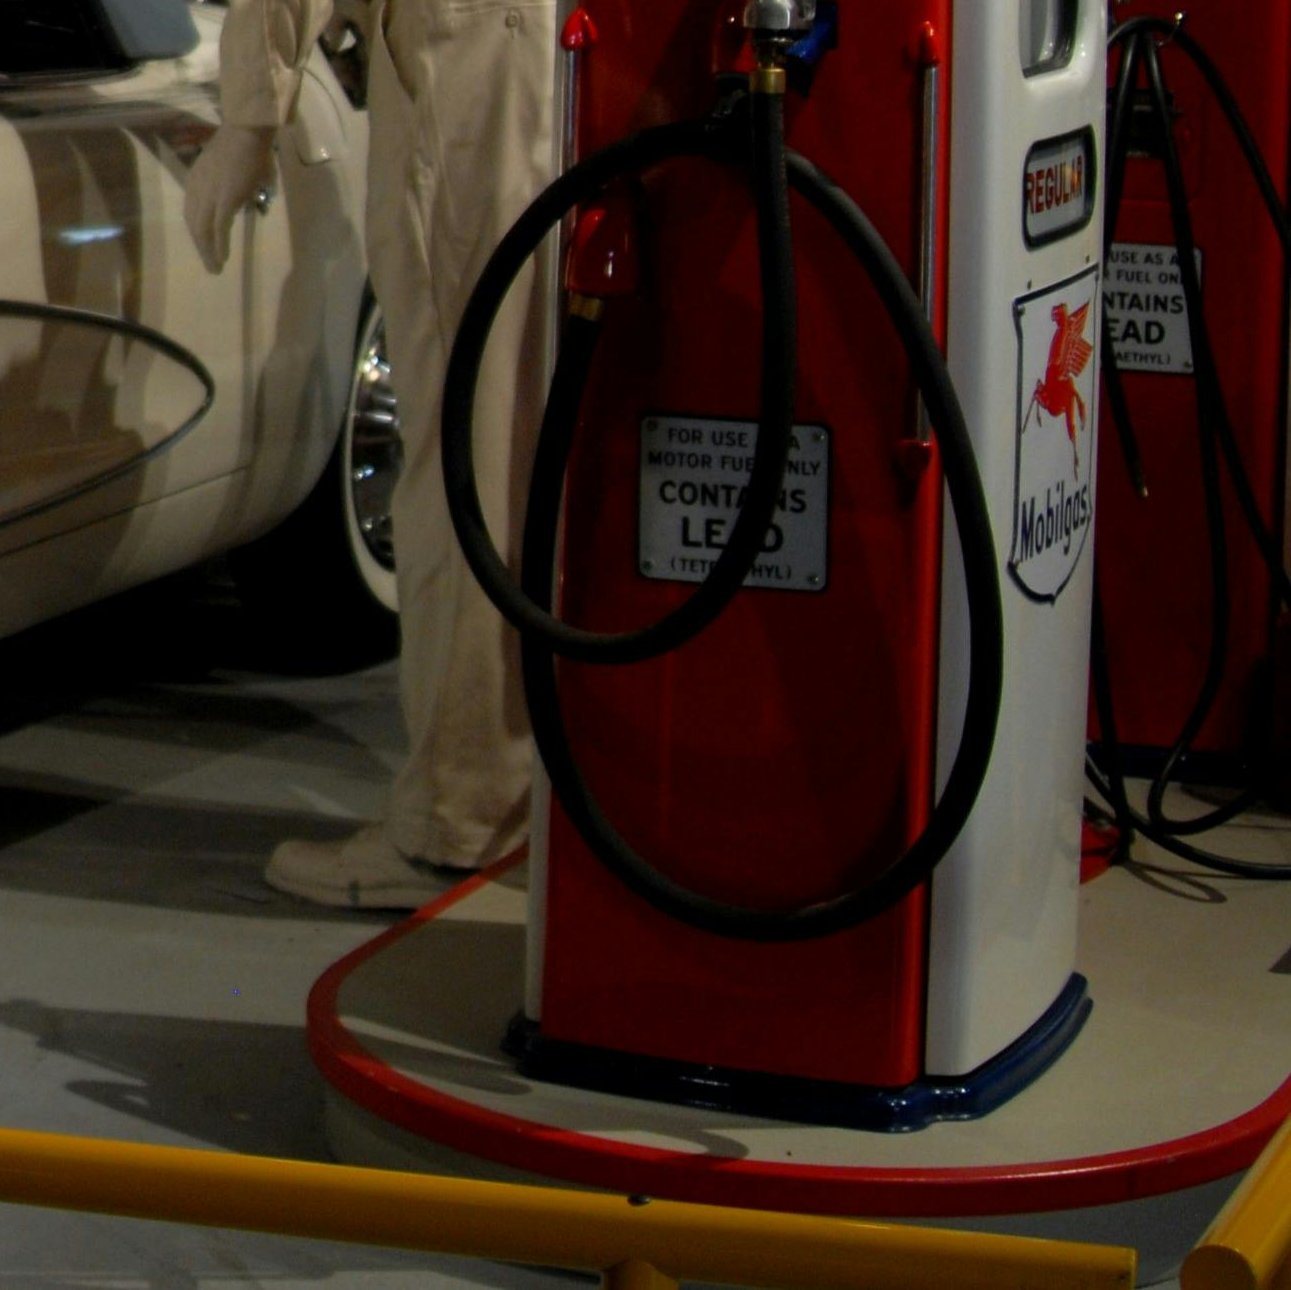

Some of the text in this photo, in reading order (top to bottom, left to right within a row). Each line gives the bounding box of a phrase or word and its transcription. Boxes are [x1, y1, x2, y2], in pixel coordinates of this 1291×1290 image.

[1026, 155, 1083, 214] REGULAR
[1144, 252, 1164, 265] AS
[1116, 269, 1151, 283] FUEL
[1103, 291, 1184, 314] NTAINS
[1107, 318, 1165, 345] EAD
[668, 428, 702, 445] FOR
[712, 431, 748, 447] USE
[648, 451, 821, 476] MOTOR FUE NLY
[1020, 480, 1088, 562] Mobilgas
[682, 516, 784, 552] LED
